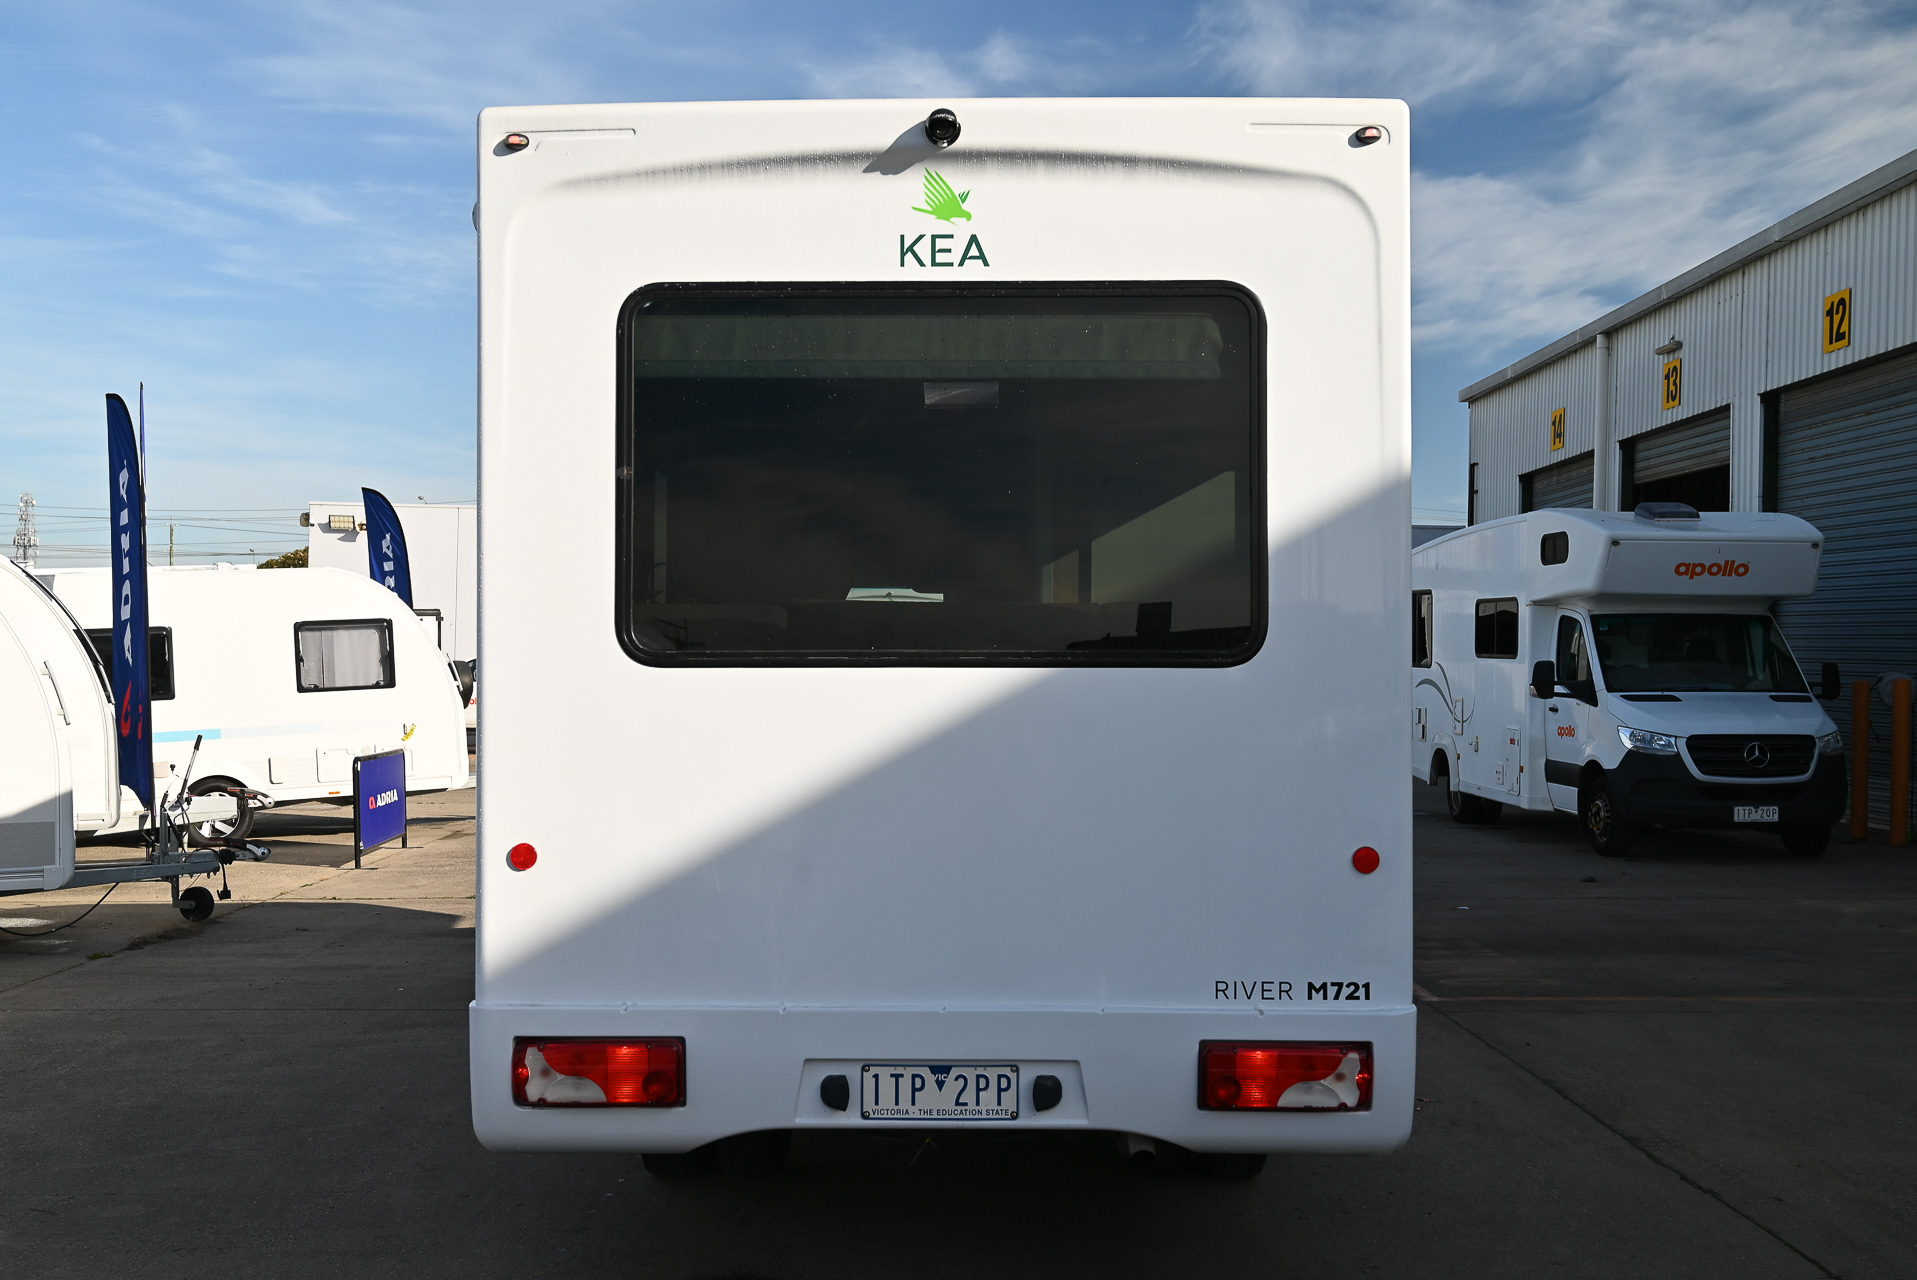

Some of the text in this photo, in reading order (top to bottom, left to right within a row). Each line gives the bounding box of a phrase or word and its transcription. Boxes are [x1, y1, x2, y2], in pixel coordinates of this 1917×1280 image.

[899, 233, 990, 267] KEA
[1826, 297, 1847, 345] 12
[1665, 365, 1678, 403] 13
[1552, 413, 1562, 445] 14
[119, 459, 132, 667] ADRIA
[381, 532, 395, 589] RIA
[1674, 560, 1750, 580] apollo
[1557, 725, 1576, 739] apollo
[376, 789, 398, 808] ADRIA
[1215, 981, 1370, 1000] RIVER M721
[872, 1073, 1012, 1107] 1TP 2PP
[936, 1109, 983, 1117] EDUCATION
[985, 1109, 1010, 1117] STATE
